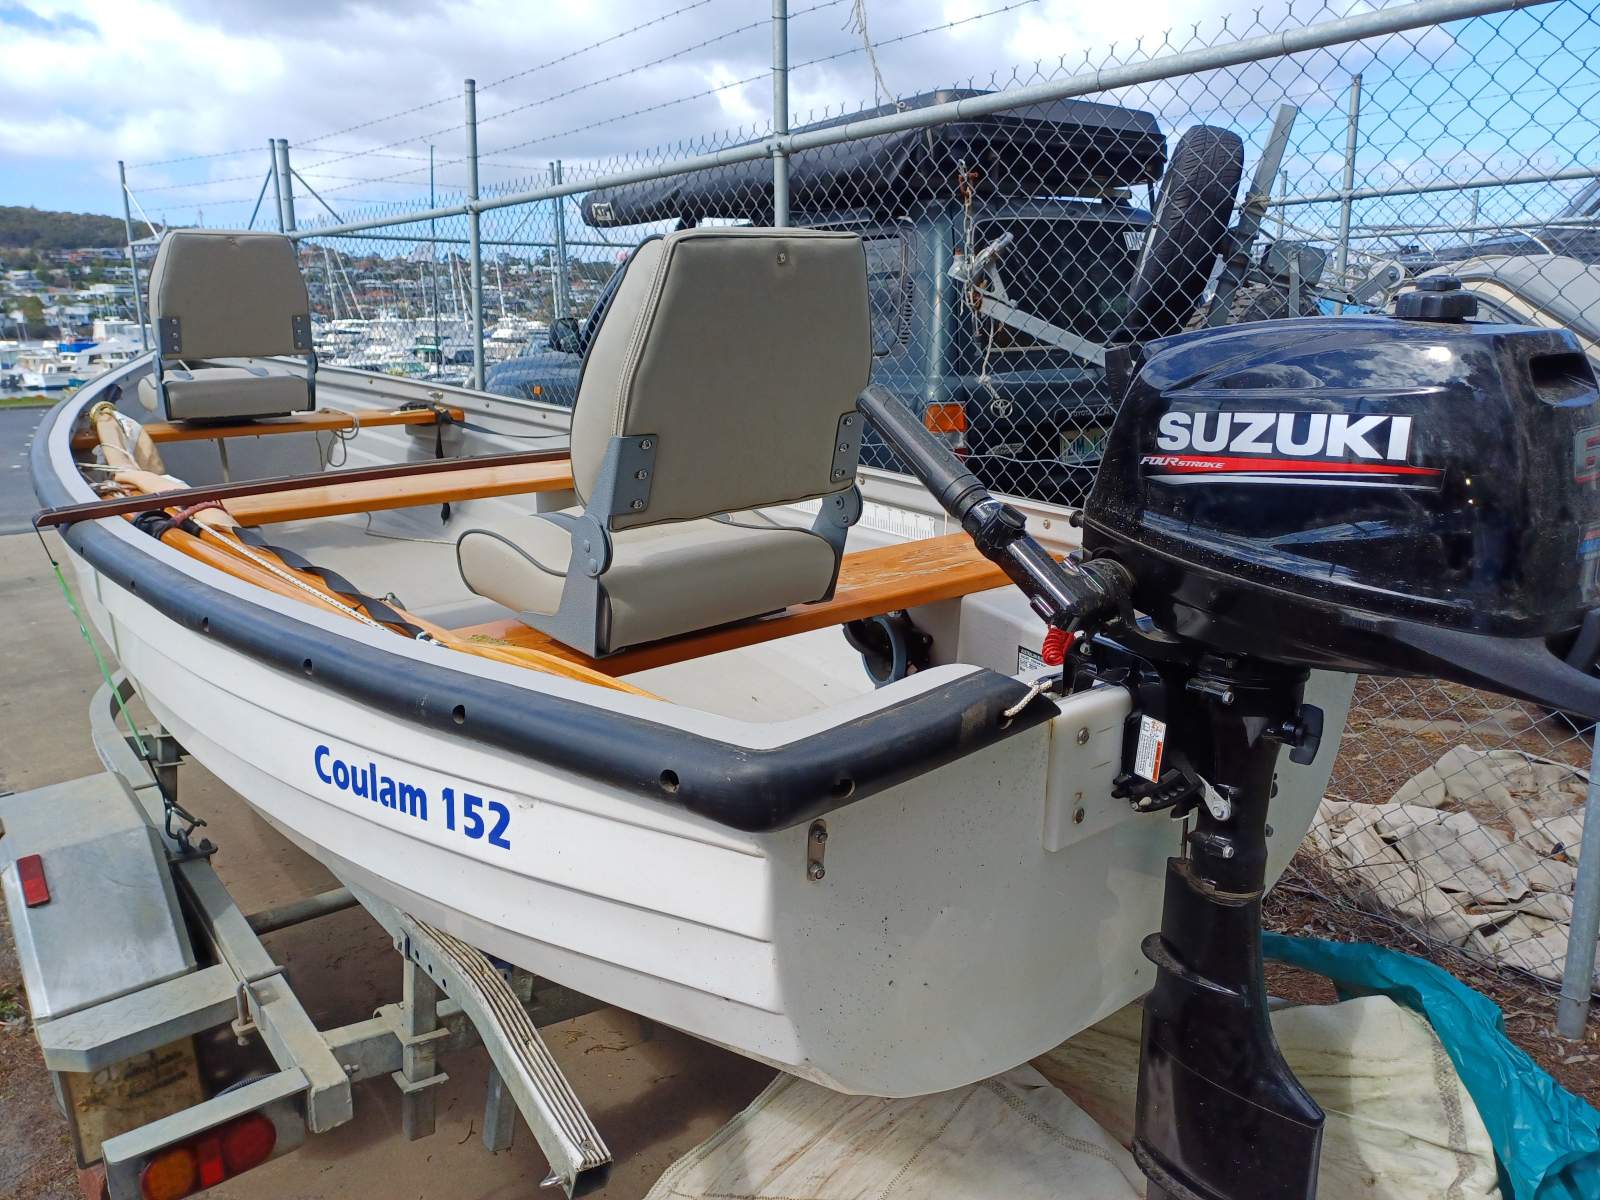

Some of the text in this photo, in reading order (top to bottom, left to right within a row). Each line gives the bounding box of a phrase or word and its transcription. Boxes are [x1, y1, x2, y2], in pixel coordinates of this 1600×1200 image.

[1157, 411, 1412, 461] SUZUKI
[314, 744, 511, 850] Coulam 152
